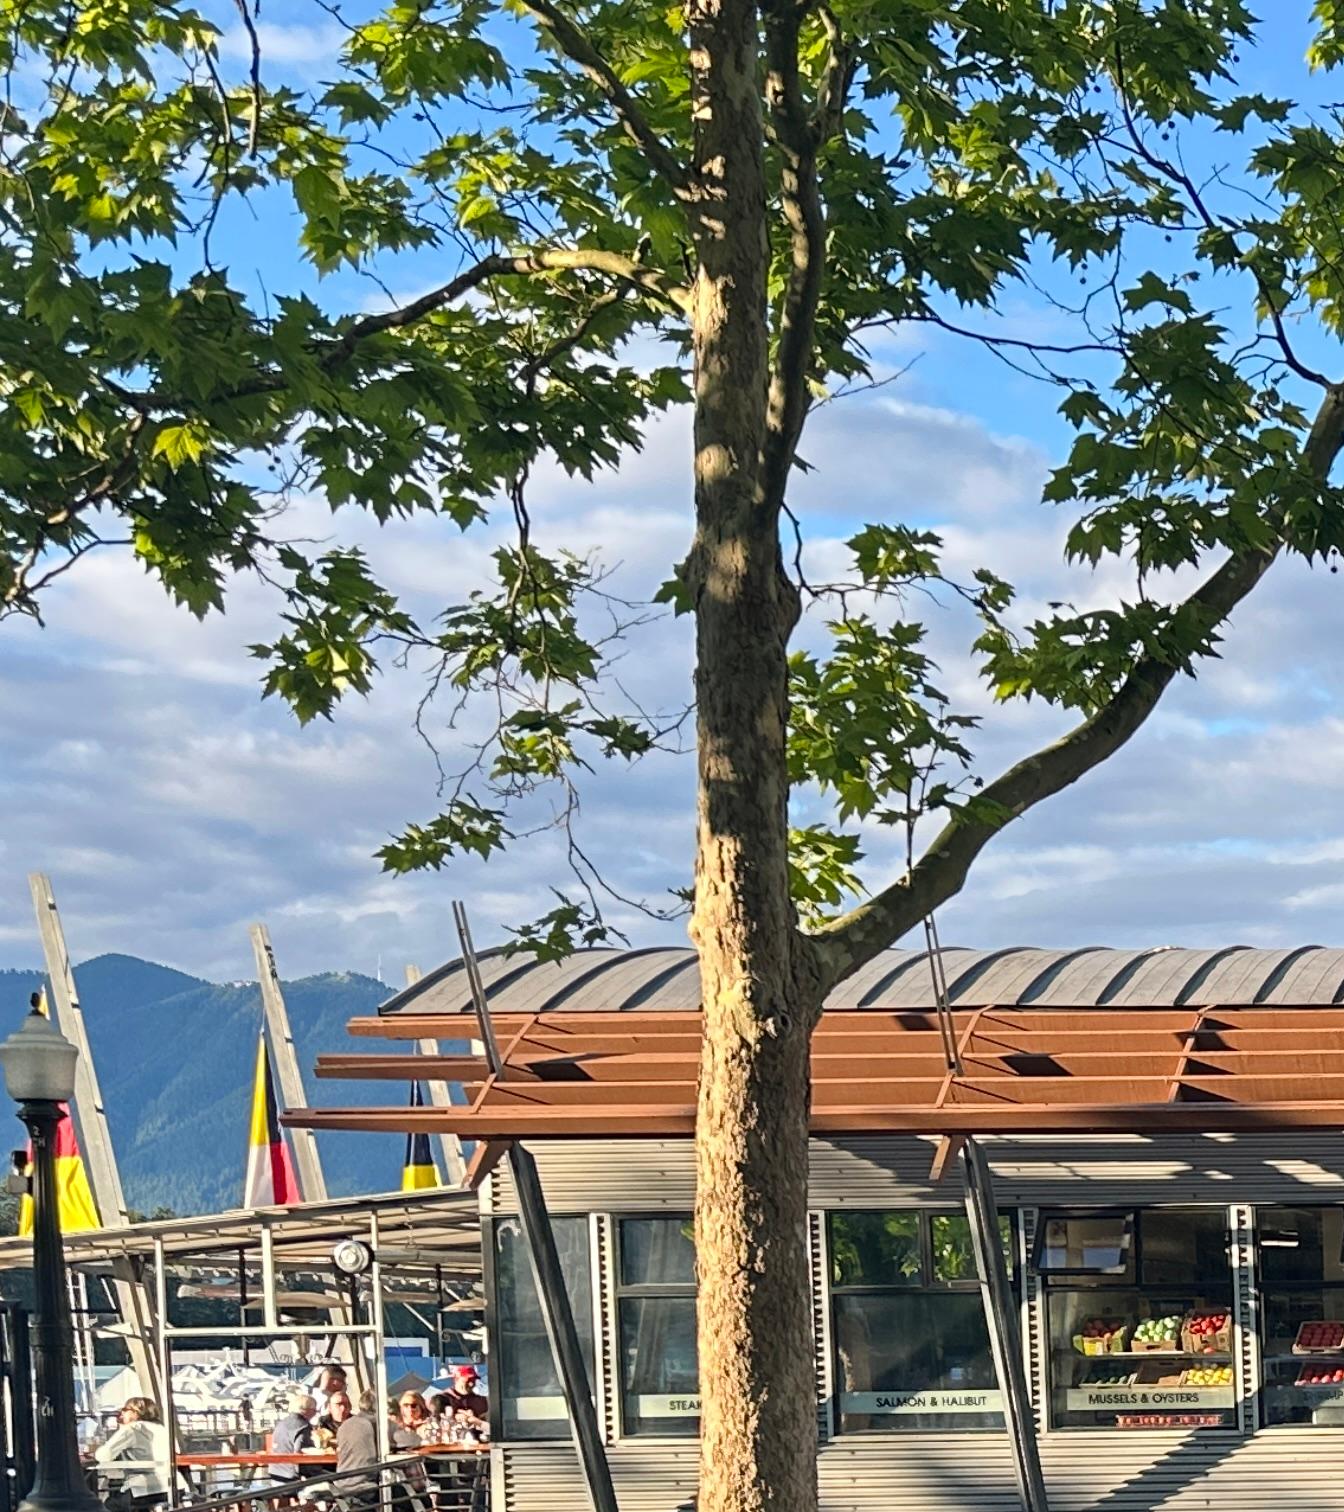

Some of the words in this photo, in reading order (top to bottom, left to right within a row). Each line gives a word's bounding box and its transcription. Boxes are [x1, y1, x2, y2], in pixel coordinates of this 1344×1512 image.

[876, 1396, 925, 1408] SALMON
[929, 1396, 938, 1407] &
[942, 1396, 987, 1407] HALIBUT
[1088, 1393, 1137, 1405] MUSSELS
[1140, 1393, 1149, 1404] &
[1152, 1392, 1200, 1404] OYSTERS
